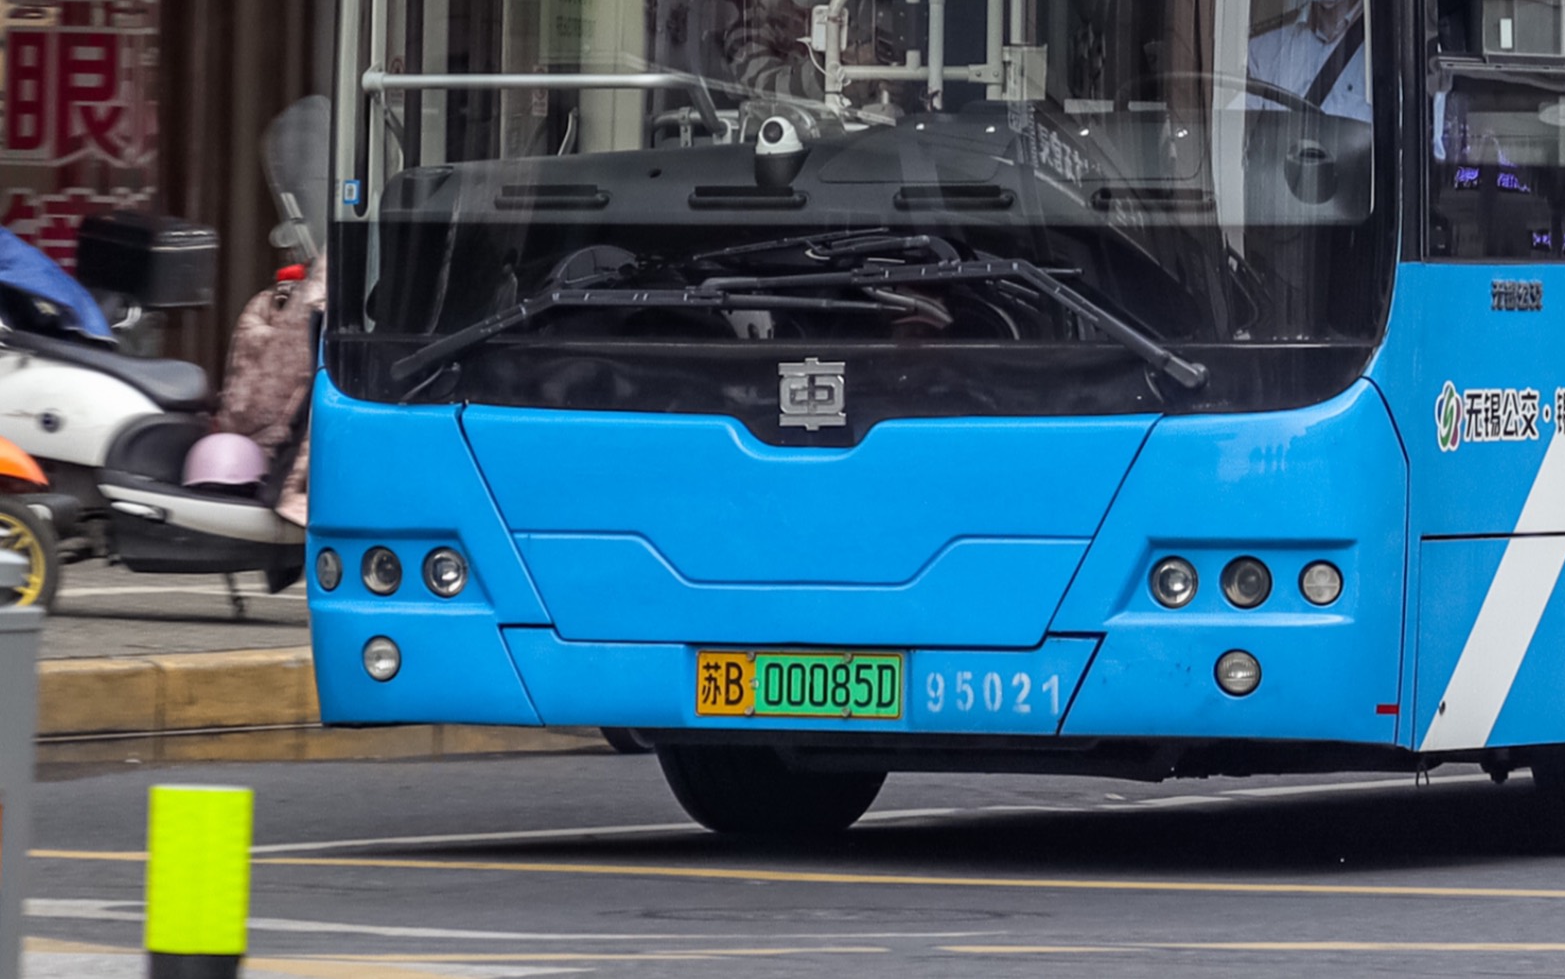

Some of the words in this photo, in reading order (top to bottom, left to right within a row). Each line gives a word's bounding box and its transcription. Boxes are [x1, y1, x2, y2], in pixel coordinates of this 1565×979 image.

[702, 661, 744, 706] 苏B
[764, 662, 896, 708] 00085D
[925, 670, 1061, 715] 95021
